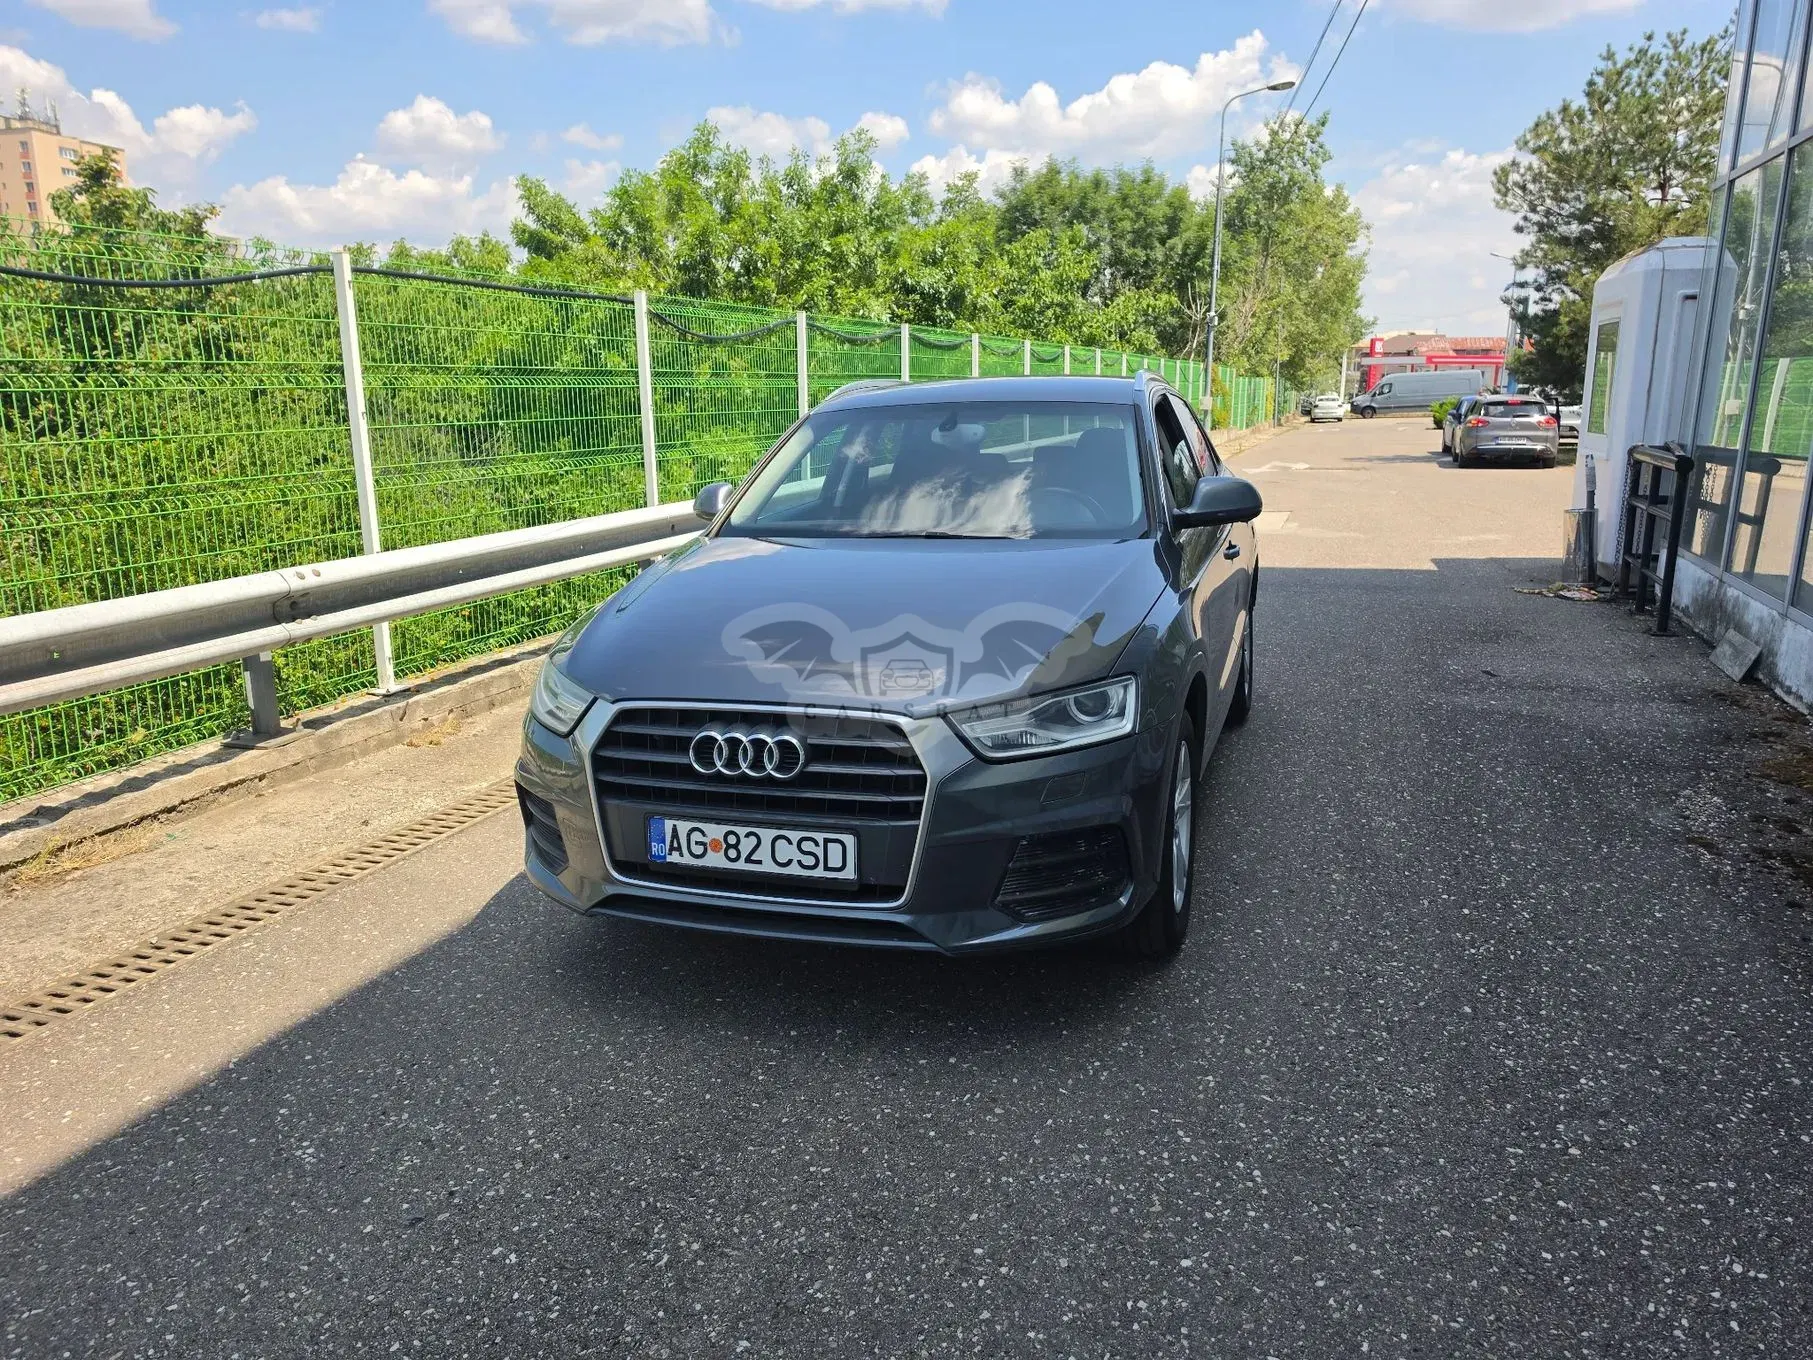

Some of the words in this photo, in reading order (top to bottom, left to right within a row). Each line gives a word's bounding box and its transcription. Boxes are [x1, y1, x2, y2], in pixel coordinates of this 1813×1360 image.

[652, 842, 666, 856] RO
[667, 824, 708, 859] AG
[723, 830, 763, 865] 82
[770, 834, 847, 873] CSD
